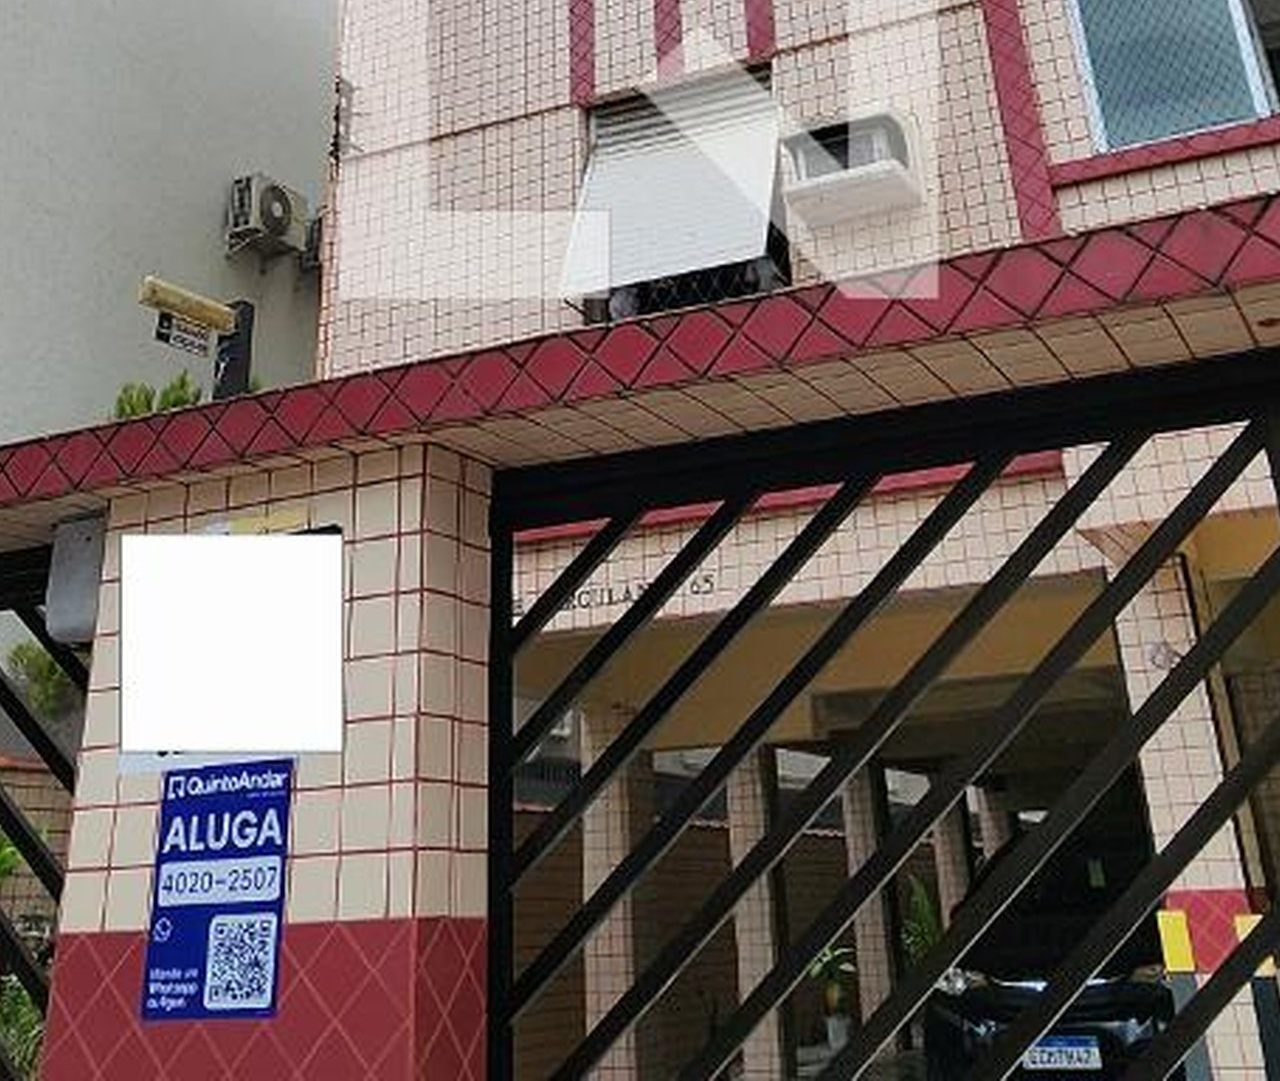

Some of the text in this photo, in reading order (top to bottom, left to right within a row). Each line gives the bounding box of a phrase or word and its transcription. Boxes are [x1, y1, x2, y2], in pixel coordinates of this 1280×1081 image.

[690, 574, 714, 595] 65
[187, 769, 287, 796] QuintoAndar
[161, 807, 282, 853] ALUGA
[161, 866, 277, 894] 4020-2507
